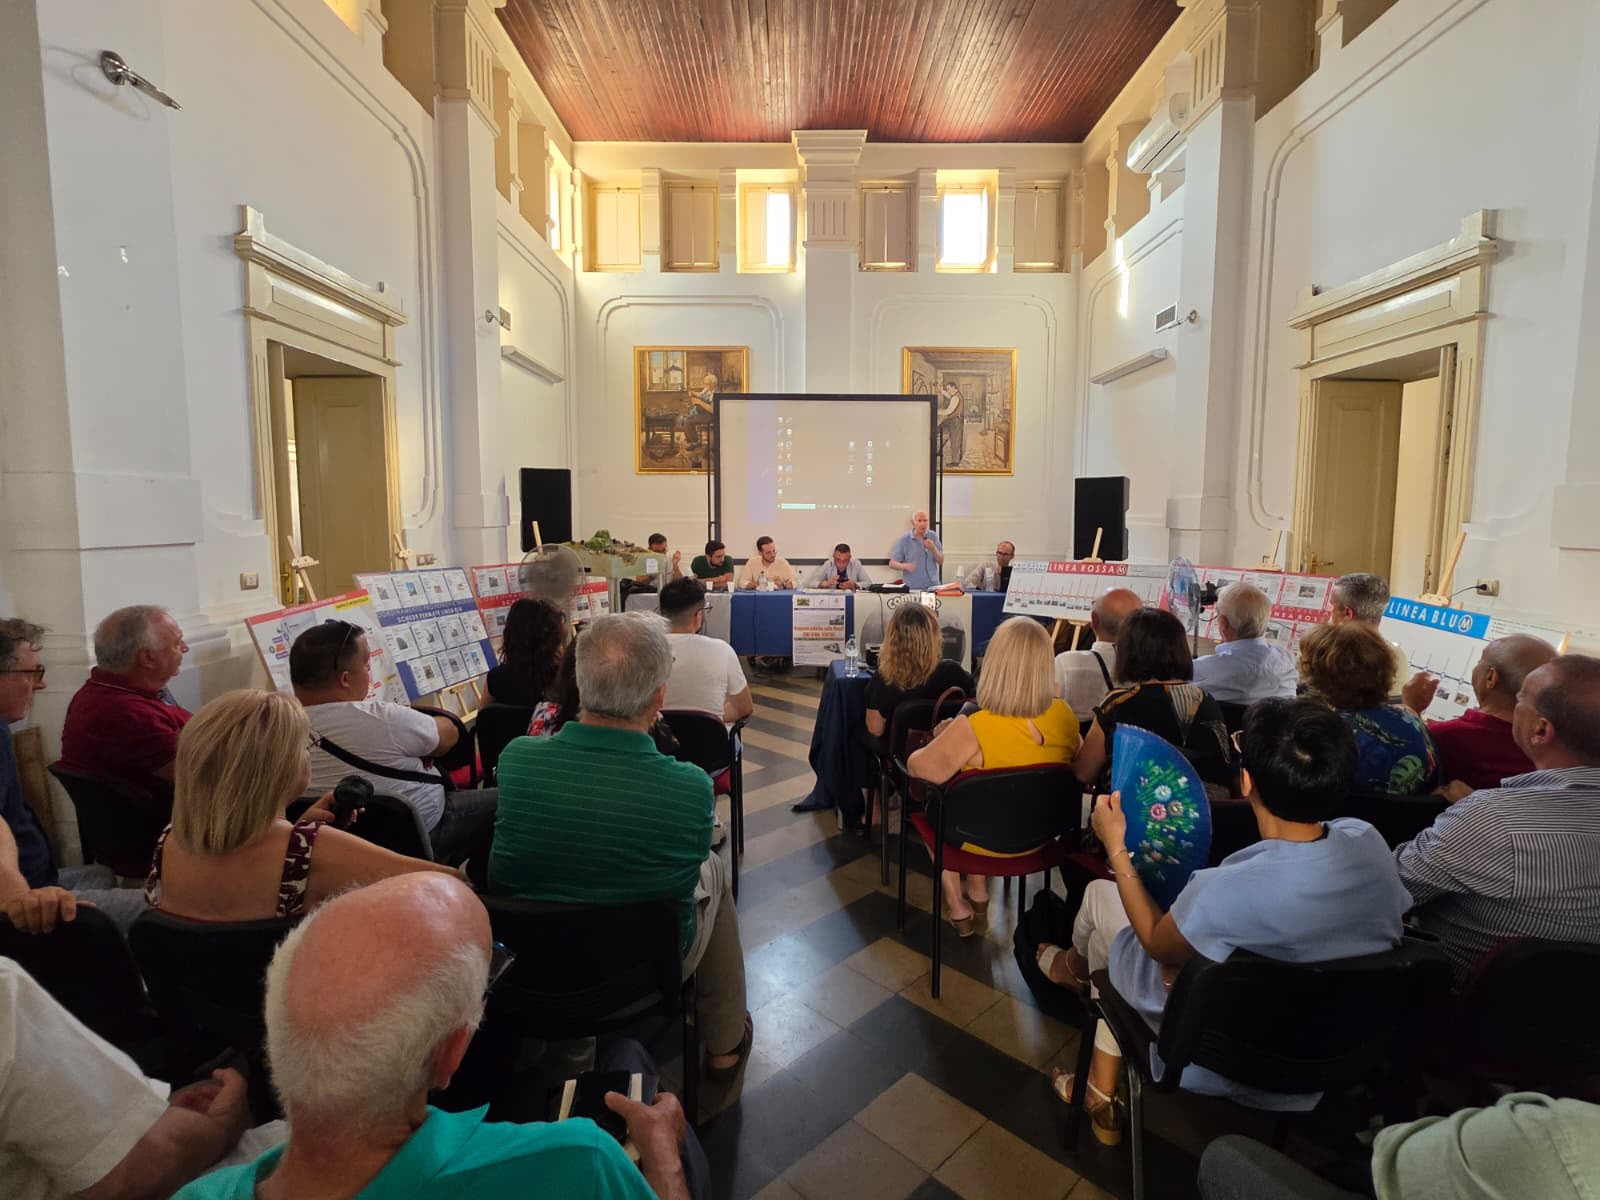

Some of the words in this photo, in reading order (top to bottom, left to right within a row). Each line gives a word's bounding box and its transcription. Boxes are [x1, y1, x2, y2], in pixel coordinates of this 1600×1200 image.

[1049, 562, 1077, 572] LINEA
[1080, 563, 1114, 574] ROSSA
[1389, 601, 1427, 621] LINEA
[1431, 609, 1459, 628] BLU
[1458, 615, 1473, 632] M
